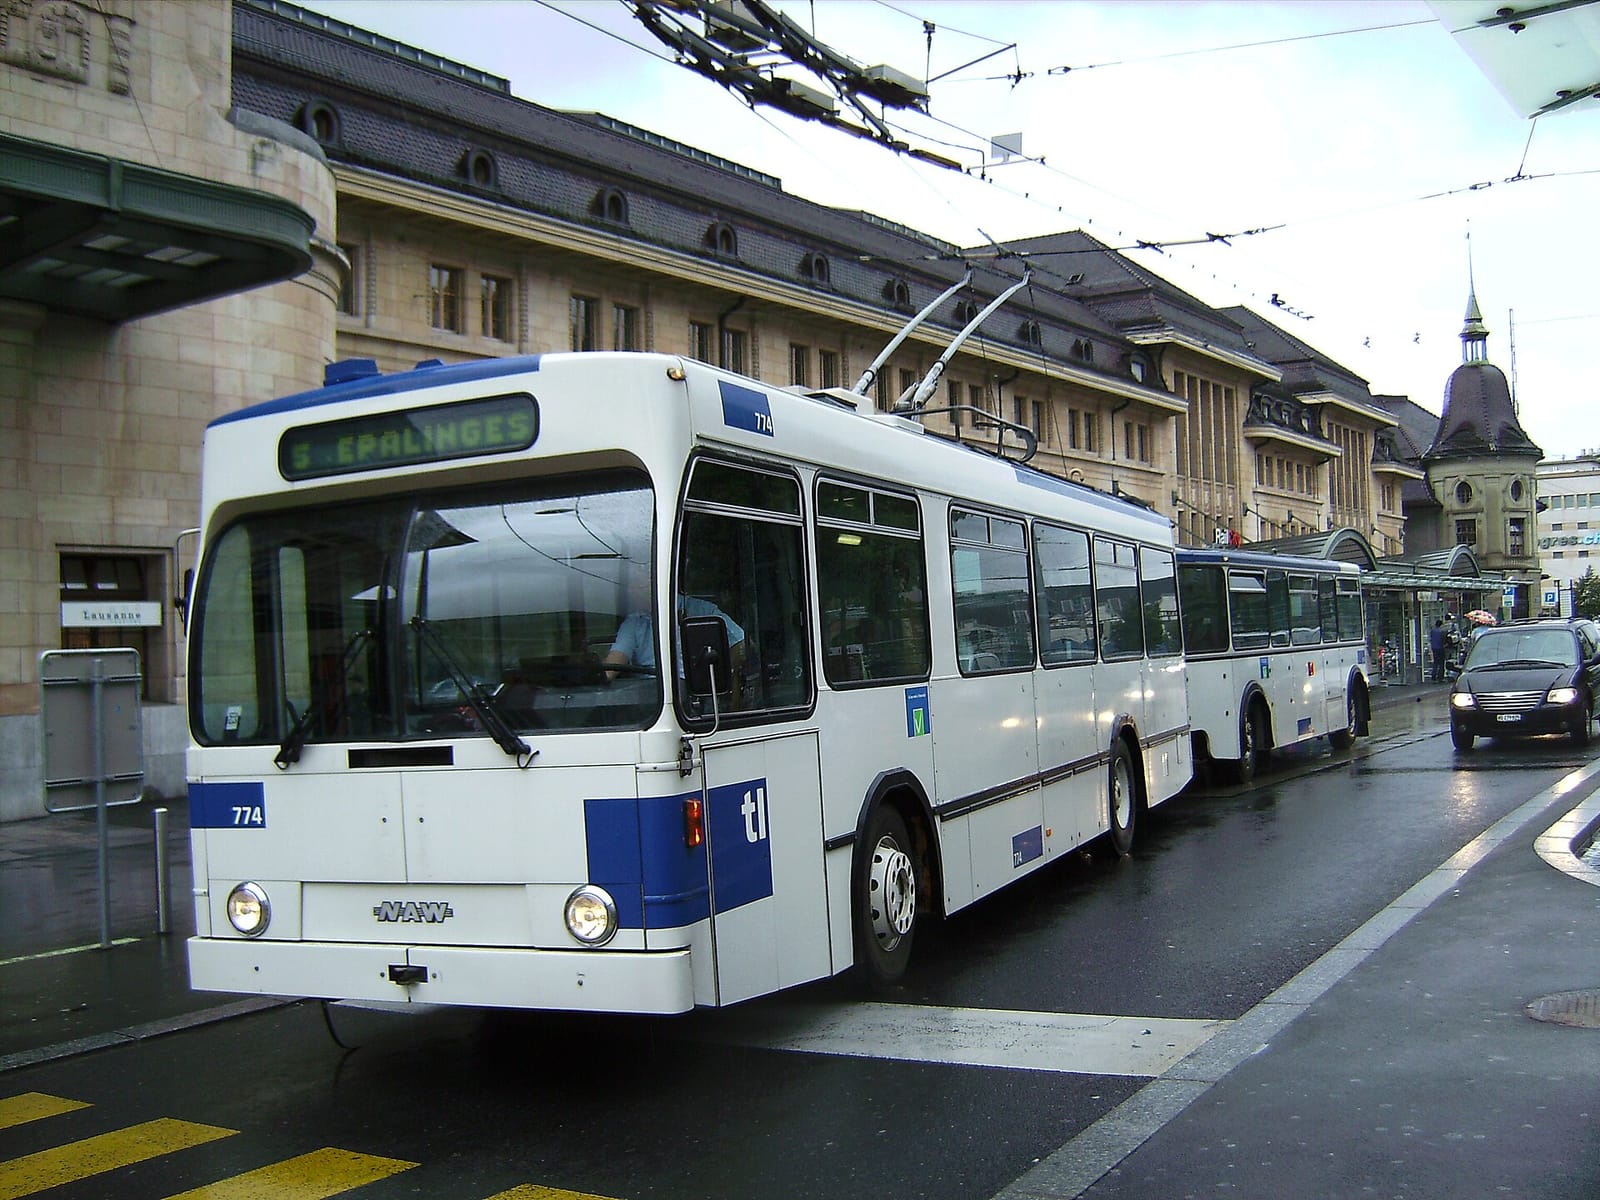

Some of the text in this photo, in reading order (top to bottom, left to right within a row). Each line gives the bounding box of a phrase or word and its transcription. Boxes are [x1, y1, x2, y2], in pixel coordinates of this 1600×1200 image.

[755, 412, 773, 433] 774
[292, 412, 531, 470] 5 EPALINGES
[83, 610, 142, 620] Lausanne
[232, 806, 263, 825] 774
[741, 788, 767, 843] tl
[376, 900, 450, 923] NAW
